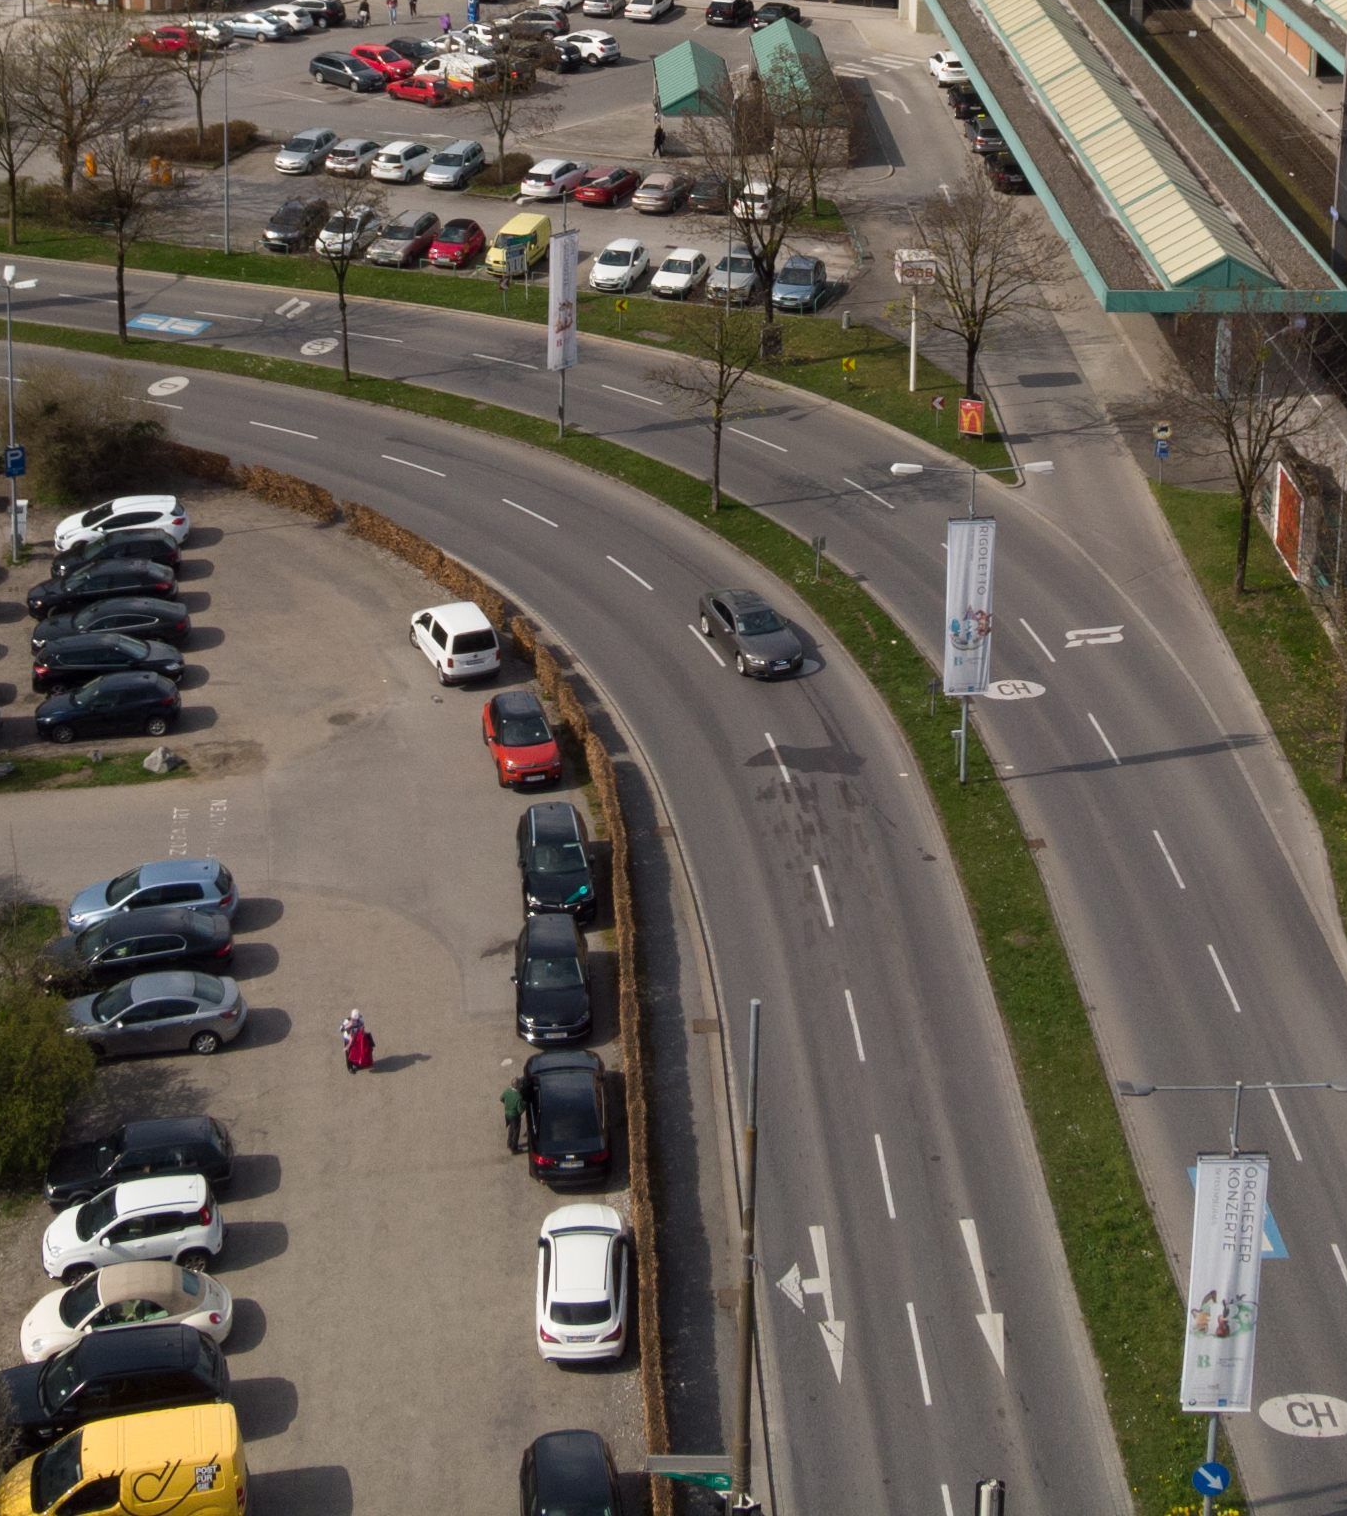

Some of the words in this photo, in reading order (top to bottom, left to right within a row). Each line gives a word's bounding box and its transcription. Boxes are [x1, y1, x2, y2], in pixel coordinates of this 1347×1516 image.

[6, 450, 23, 469] P
[977, 526, 988, 595] RIGOLETTO
[997, 682, 1032, 697] CH
[1222, 1167, 1241, 1252] KONZERTE
[1238, 1166, 1258, 1263] ORCHESTER
[1286, 1400, 1339, 1429] CH
